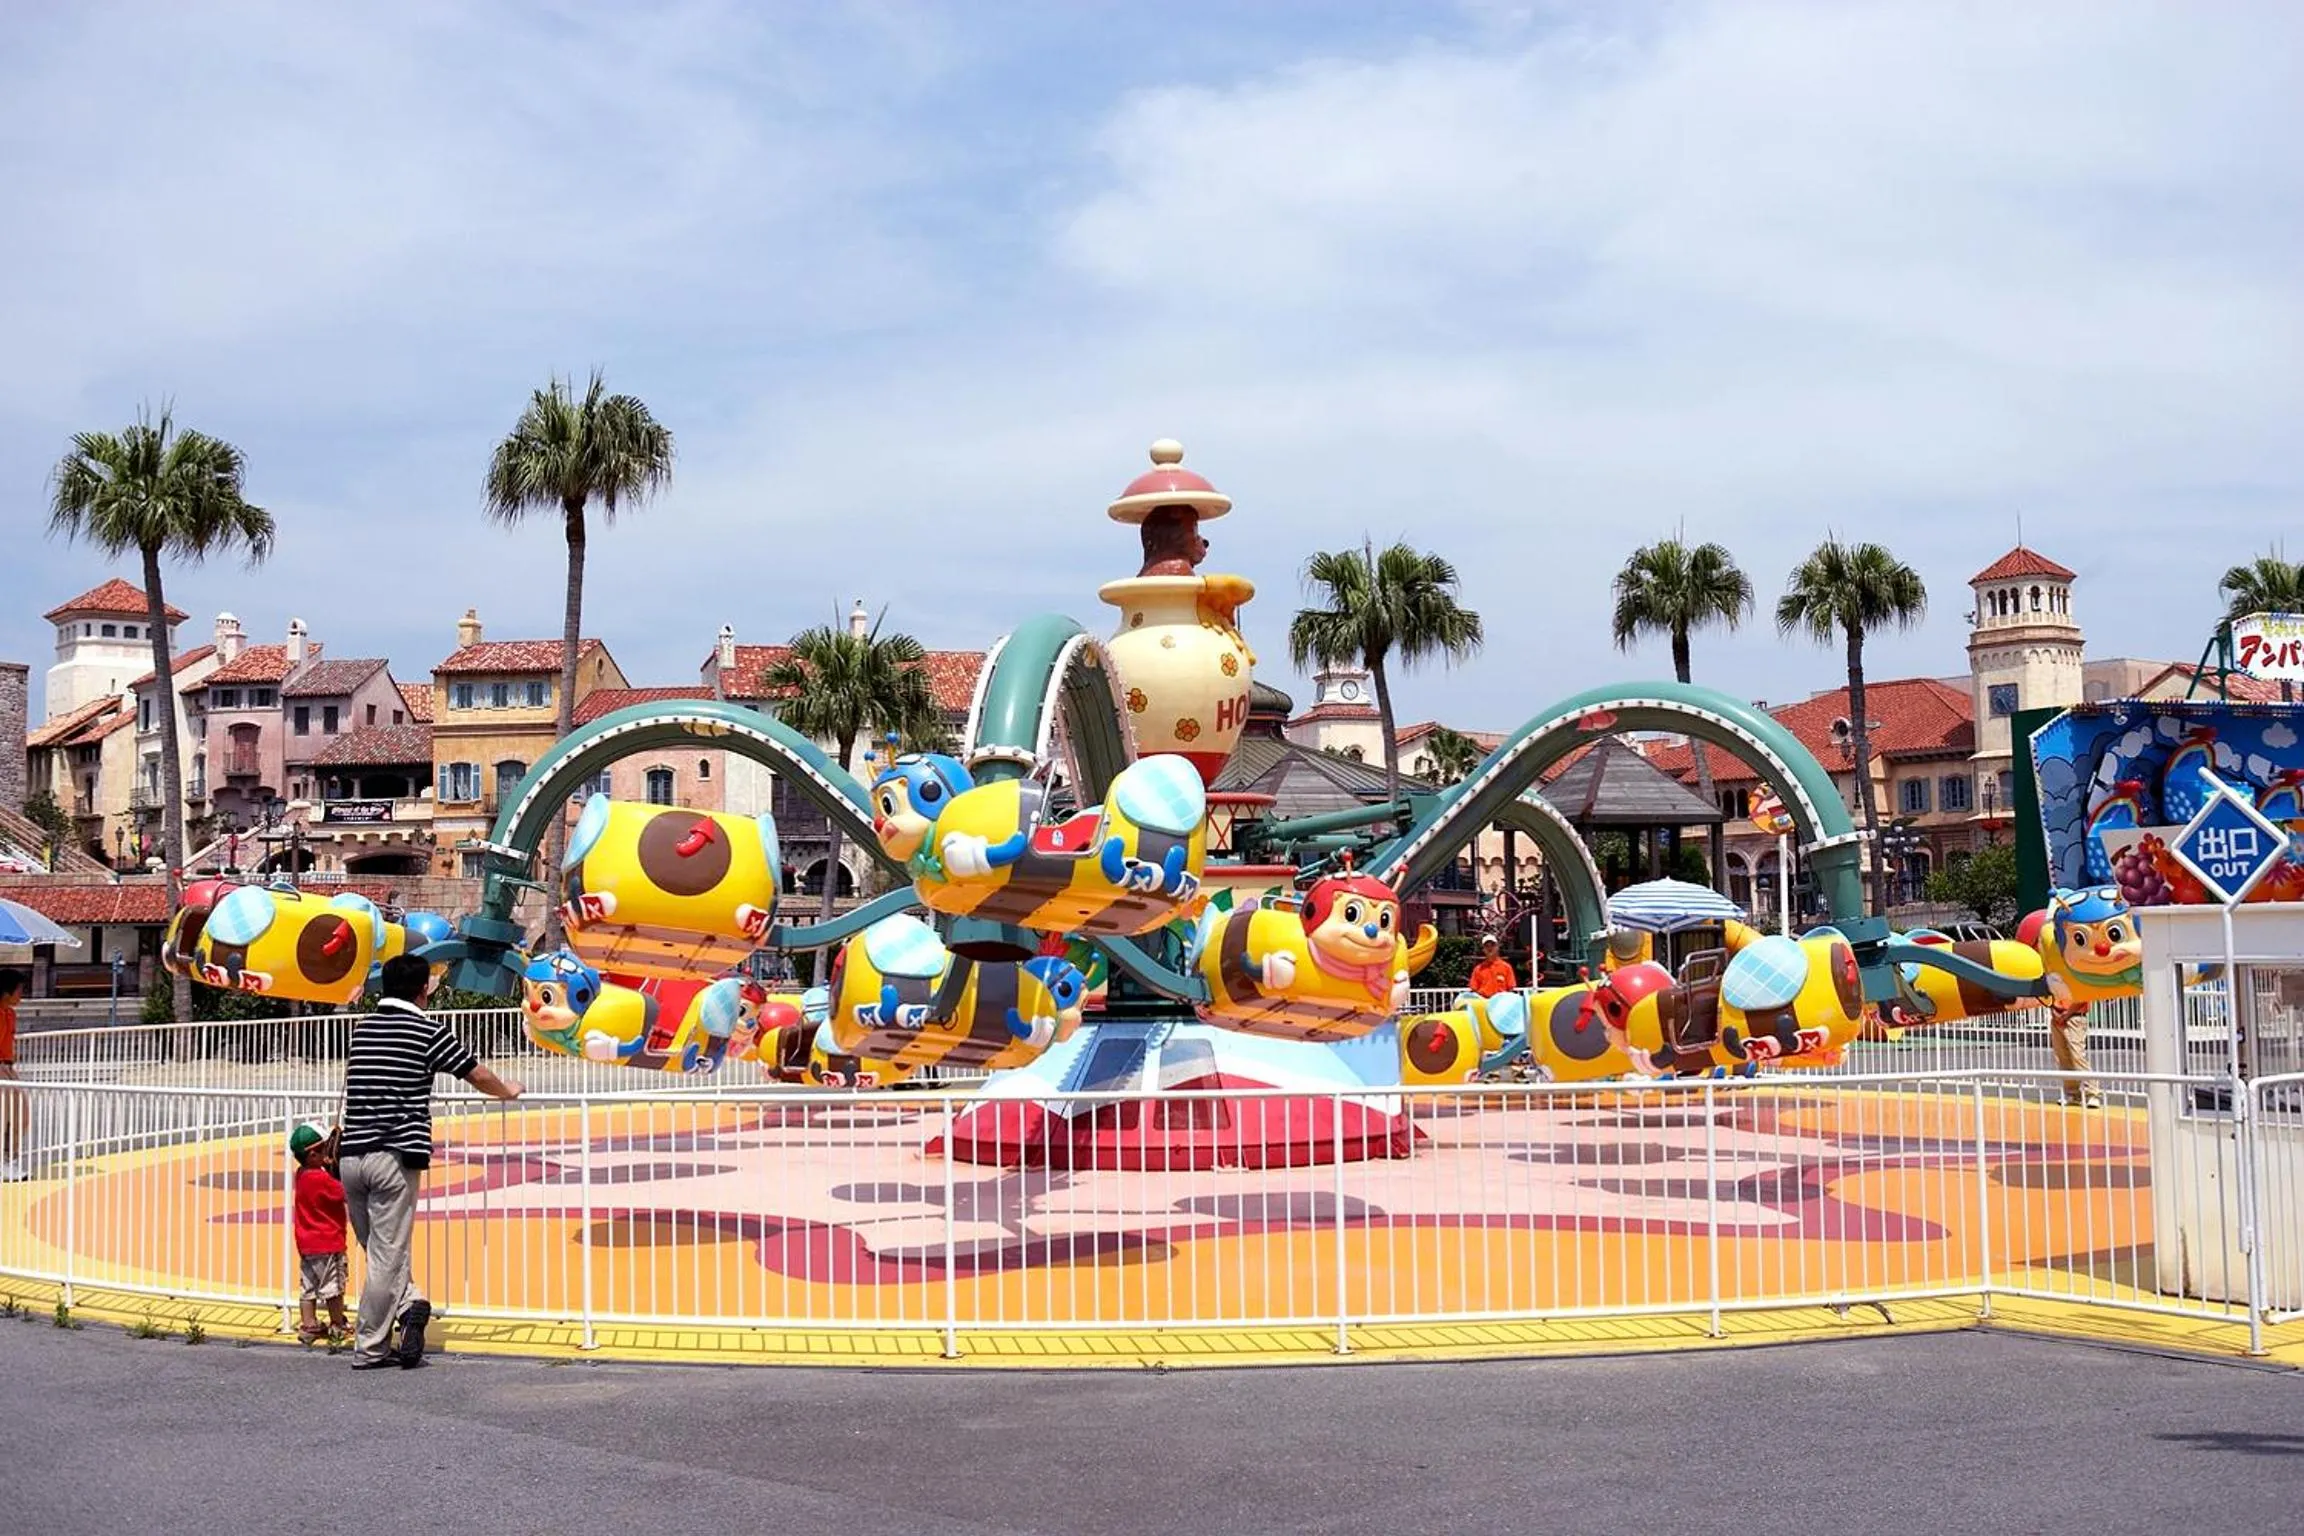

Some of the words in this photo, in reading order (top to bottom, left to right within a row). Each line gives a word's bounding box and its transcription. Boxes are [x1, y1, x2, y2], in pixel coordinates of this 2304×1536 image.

[2240, 635, 2304, 668] アンパ
[1216, 690, 1250, 732] HO
[2198, 827, 2258, 861] 出口
[2211, 861, 2250, 877] OUT
